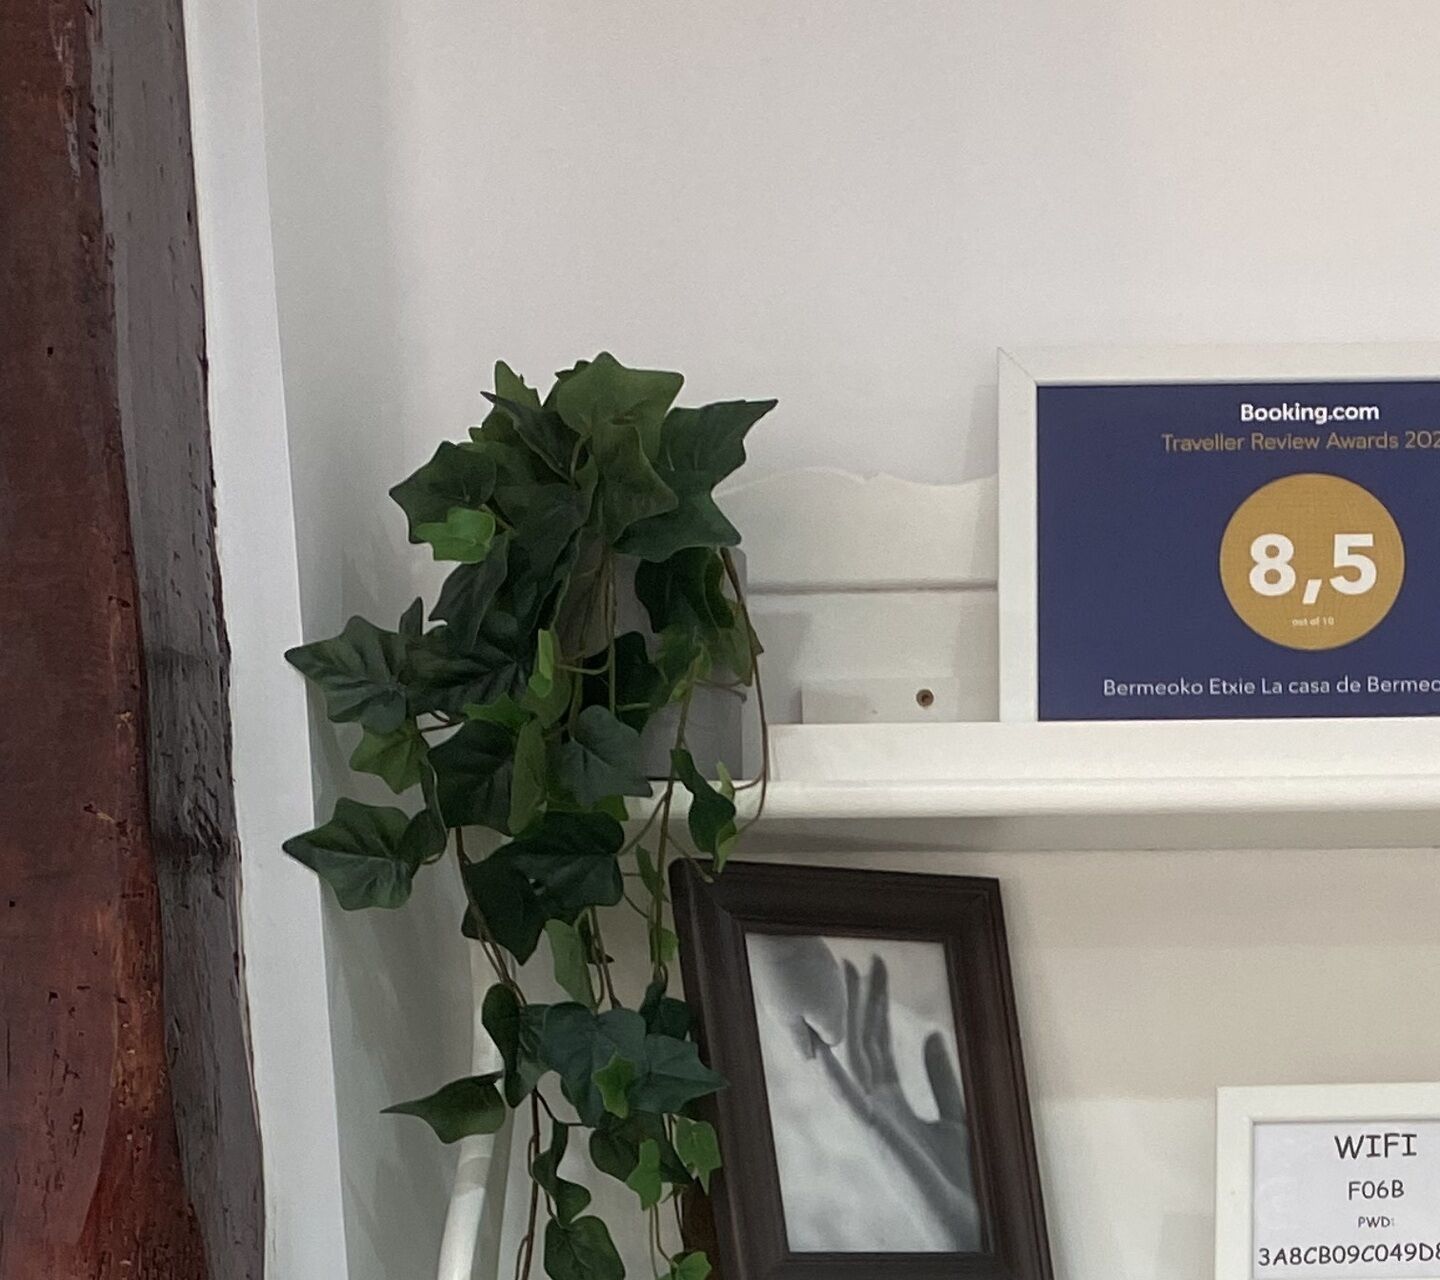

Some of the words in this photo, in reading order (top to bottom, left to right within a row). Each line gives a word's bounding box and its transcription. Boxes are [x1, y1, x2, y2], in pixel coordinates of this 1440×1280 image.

[1240, 403, 1380, 424] Booking.com
[1161, 432, 1246, 452] Traveller
[1252, 432, 1321, 450] Review
[1326, 430, 1399, 449] Awards
[1249, 533, 1378, 606] 8,5
[1291, 617, 1308, 626] out
[1310, 616, 1320, 626] of
[1323, 616, 1335, 626] 10
[1103, 678, 1204, 697] Bermeoko
[1209, 678, 1256, 696] Etxie
[1261, 677, 1283, 695] La
[1288, 681, 1332, 695] casa
[1336, 675, 1362, 694] de
[1334, 1133, 1418, 1159] WIFI
[1347, 1179, 1405, 1201] F06B
